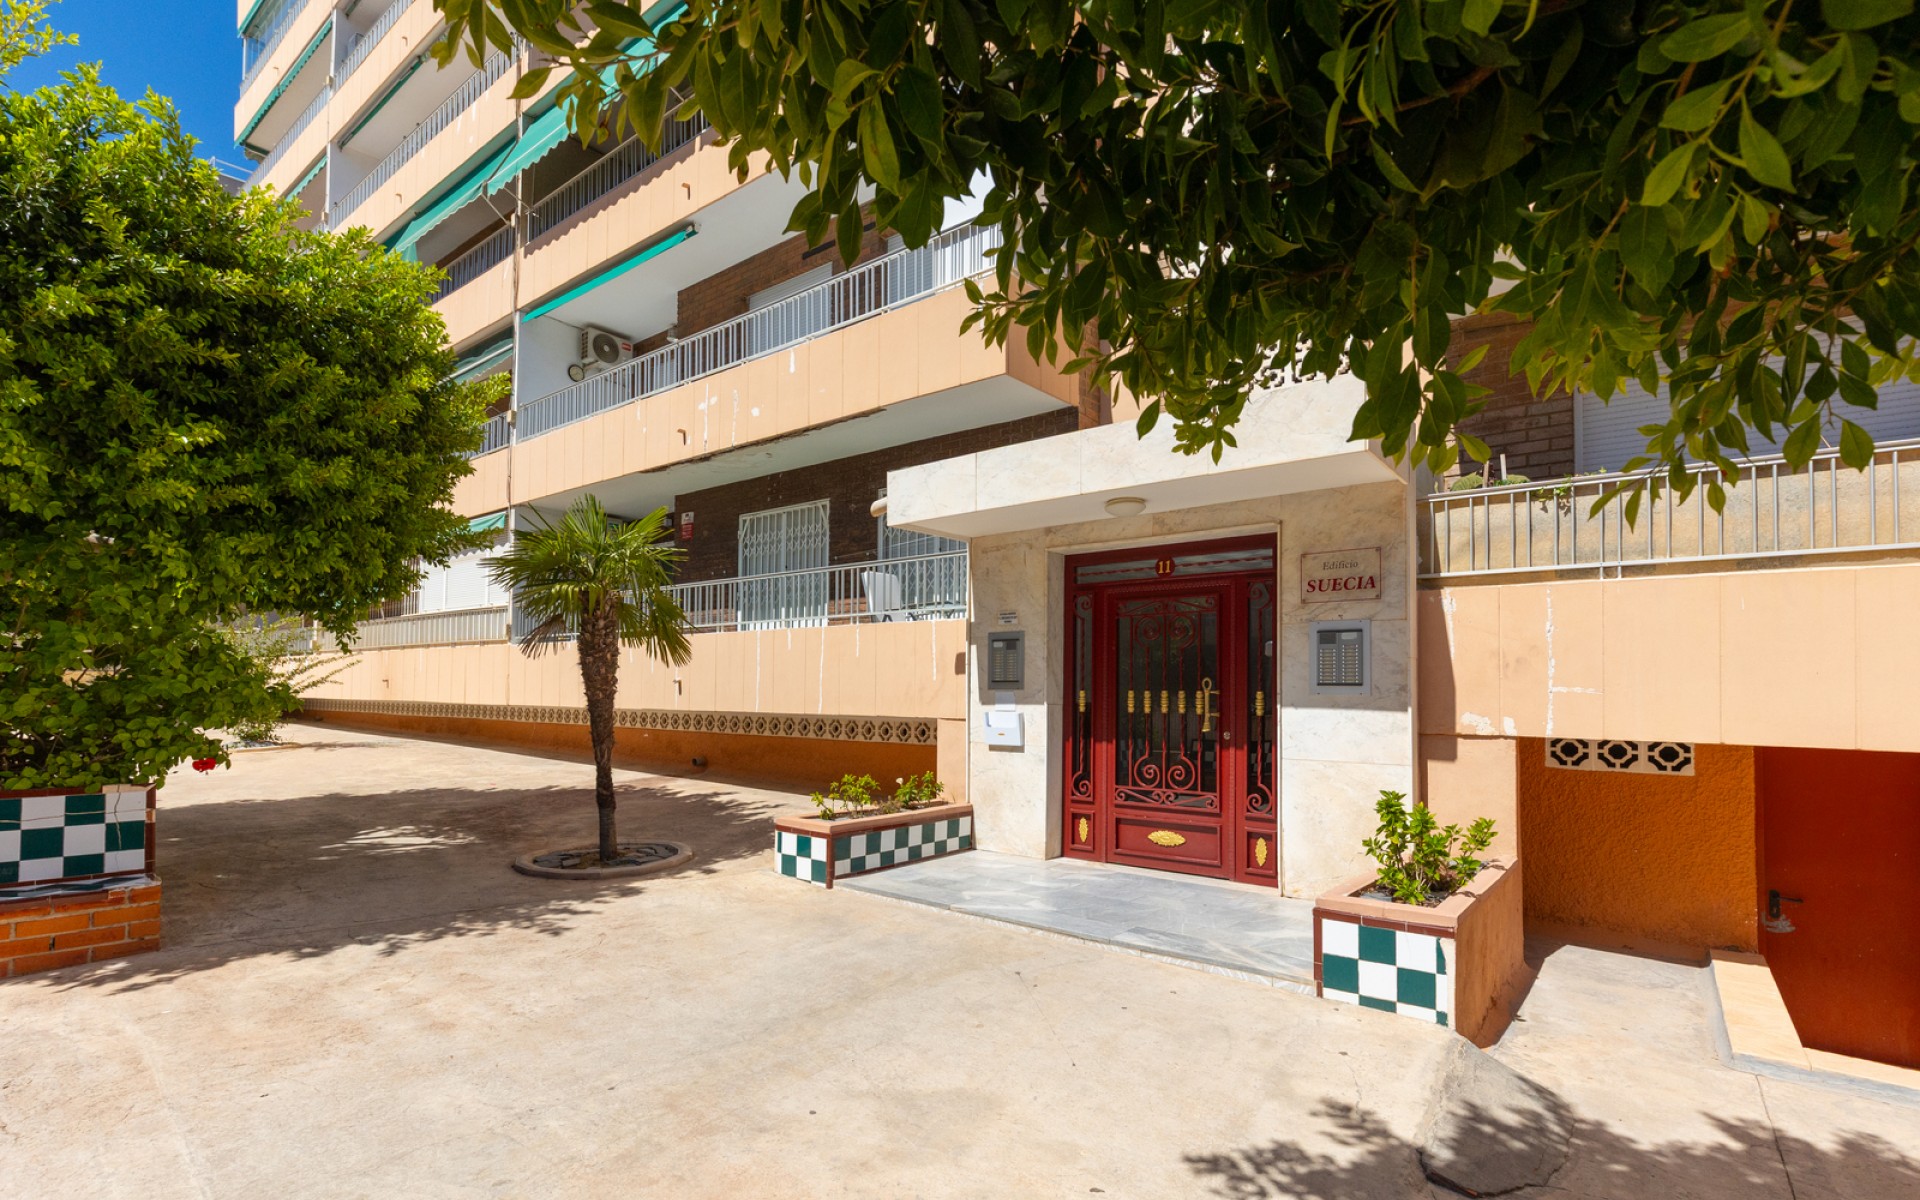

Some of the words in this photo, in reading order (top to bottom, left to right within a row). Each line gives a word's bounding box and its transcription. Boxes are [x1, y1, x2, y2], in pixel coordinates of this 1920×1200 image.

[1158, 560, 1171, 574] 11
[1322, 560, 1359, 571] Edificio
[1306, 575, 1376, 593] SUECIA
